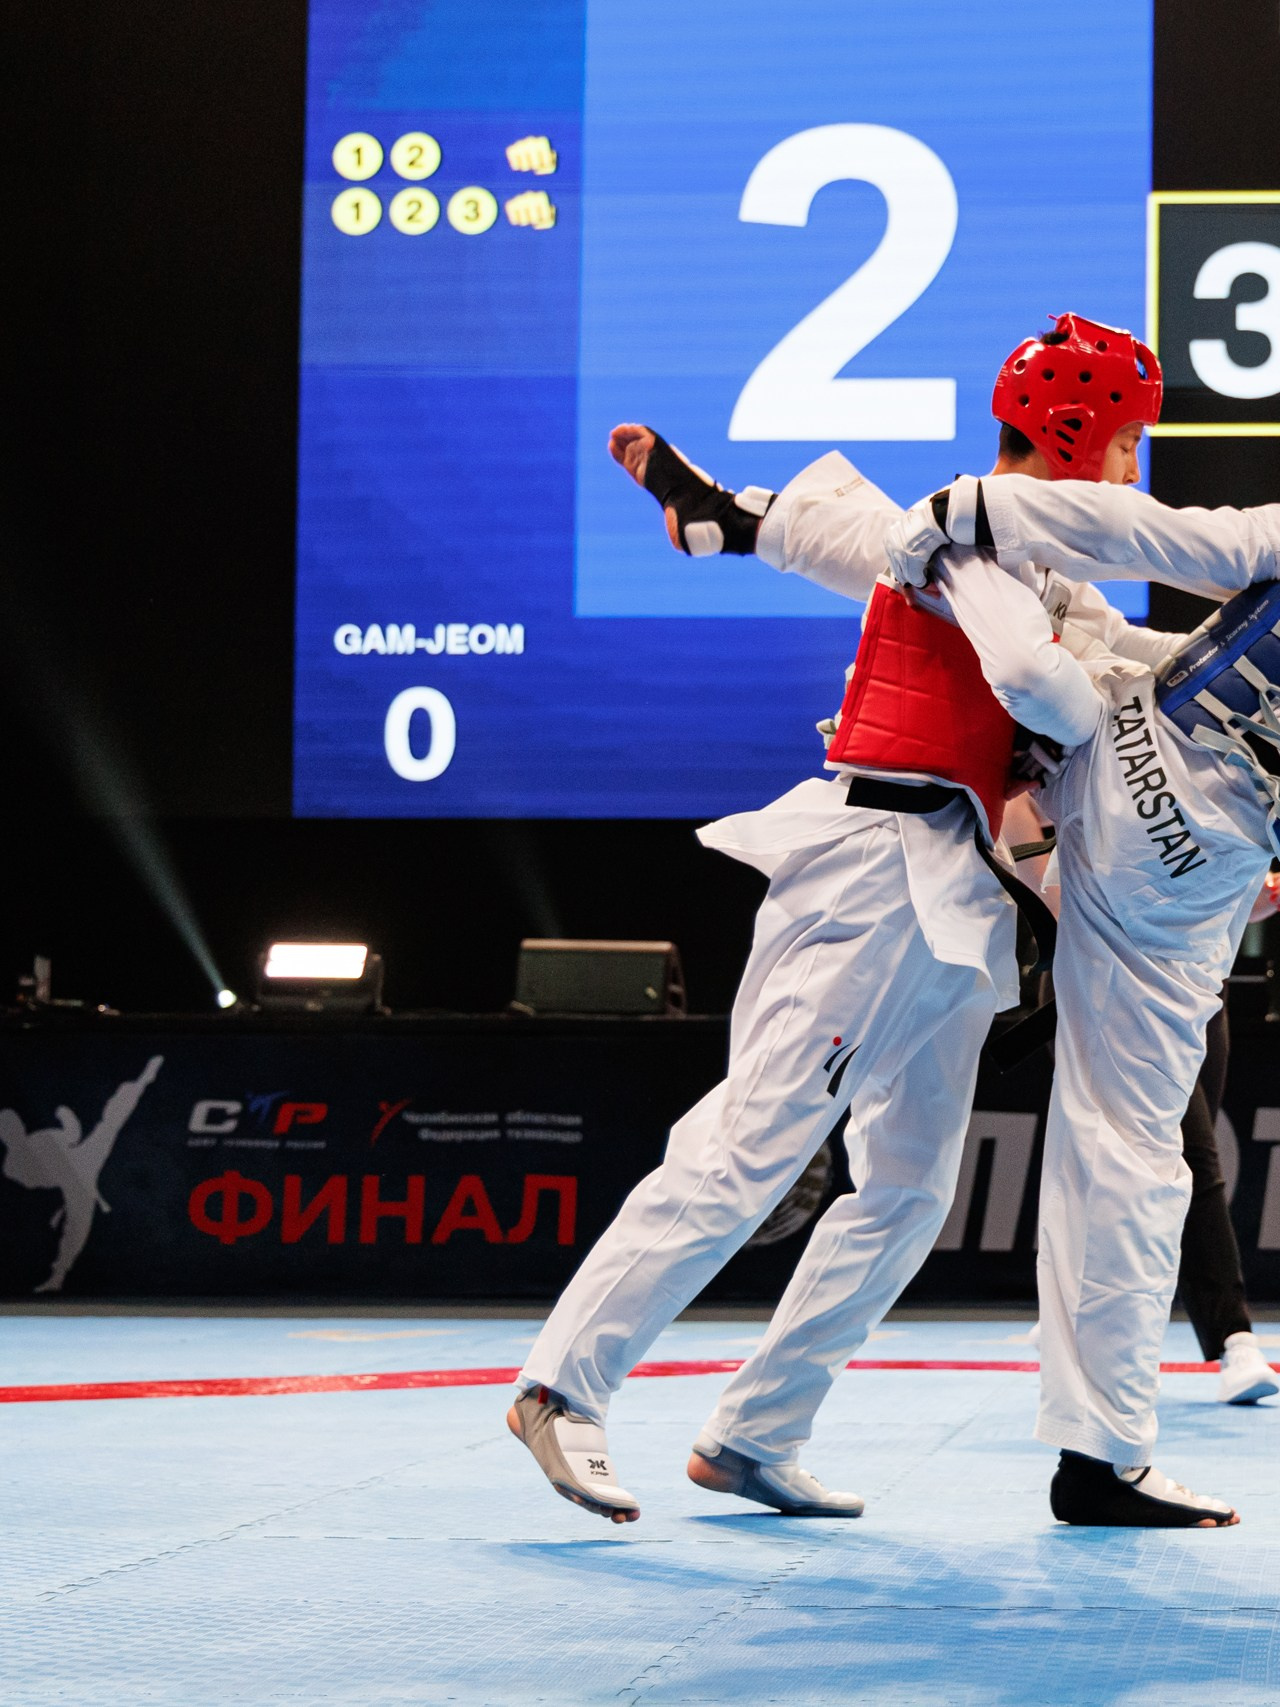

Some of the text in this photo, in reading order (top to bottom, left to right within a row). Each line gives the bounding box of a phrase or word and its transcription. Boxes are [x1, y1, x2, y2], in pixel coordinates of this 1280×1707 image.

[408, 145, 424, 168] 2
[406, 200, 423, 223] 2
[464, 199, 480, 223] 3
[729, 122, 959, 442] 2
[334, 623, 525, 655] GAM-JEOM
[384, 686, 457, 782] 0
[1113, 696, 1207, 879] TATARSTAN
[189, 1170, 579, 1246] ФИНАЛ
